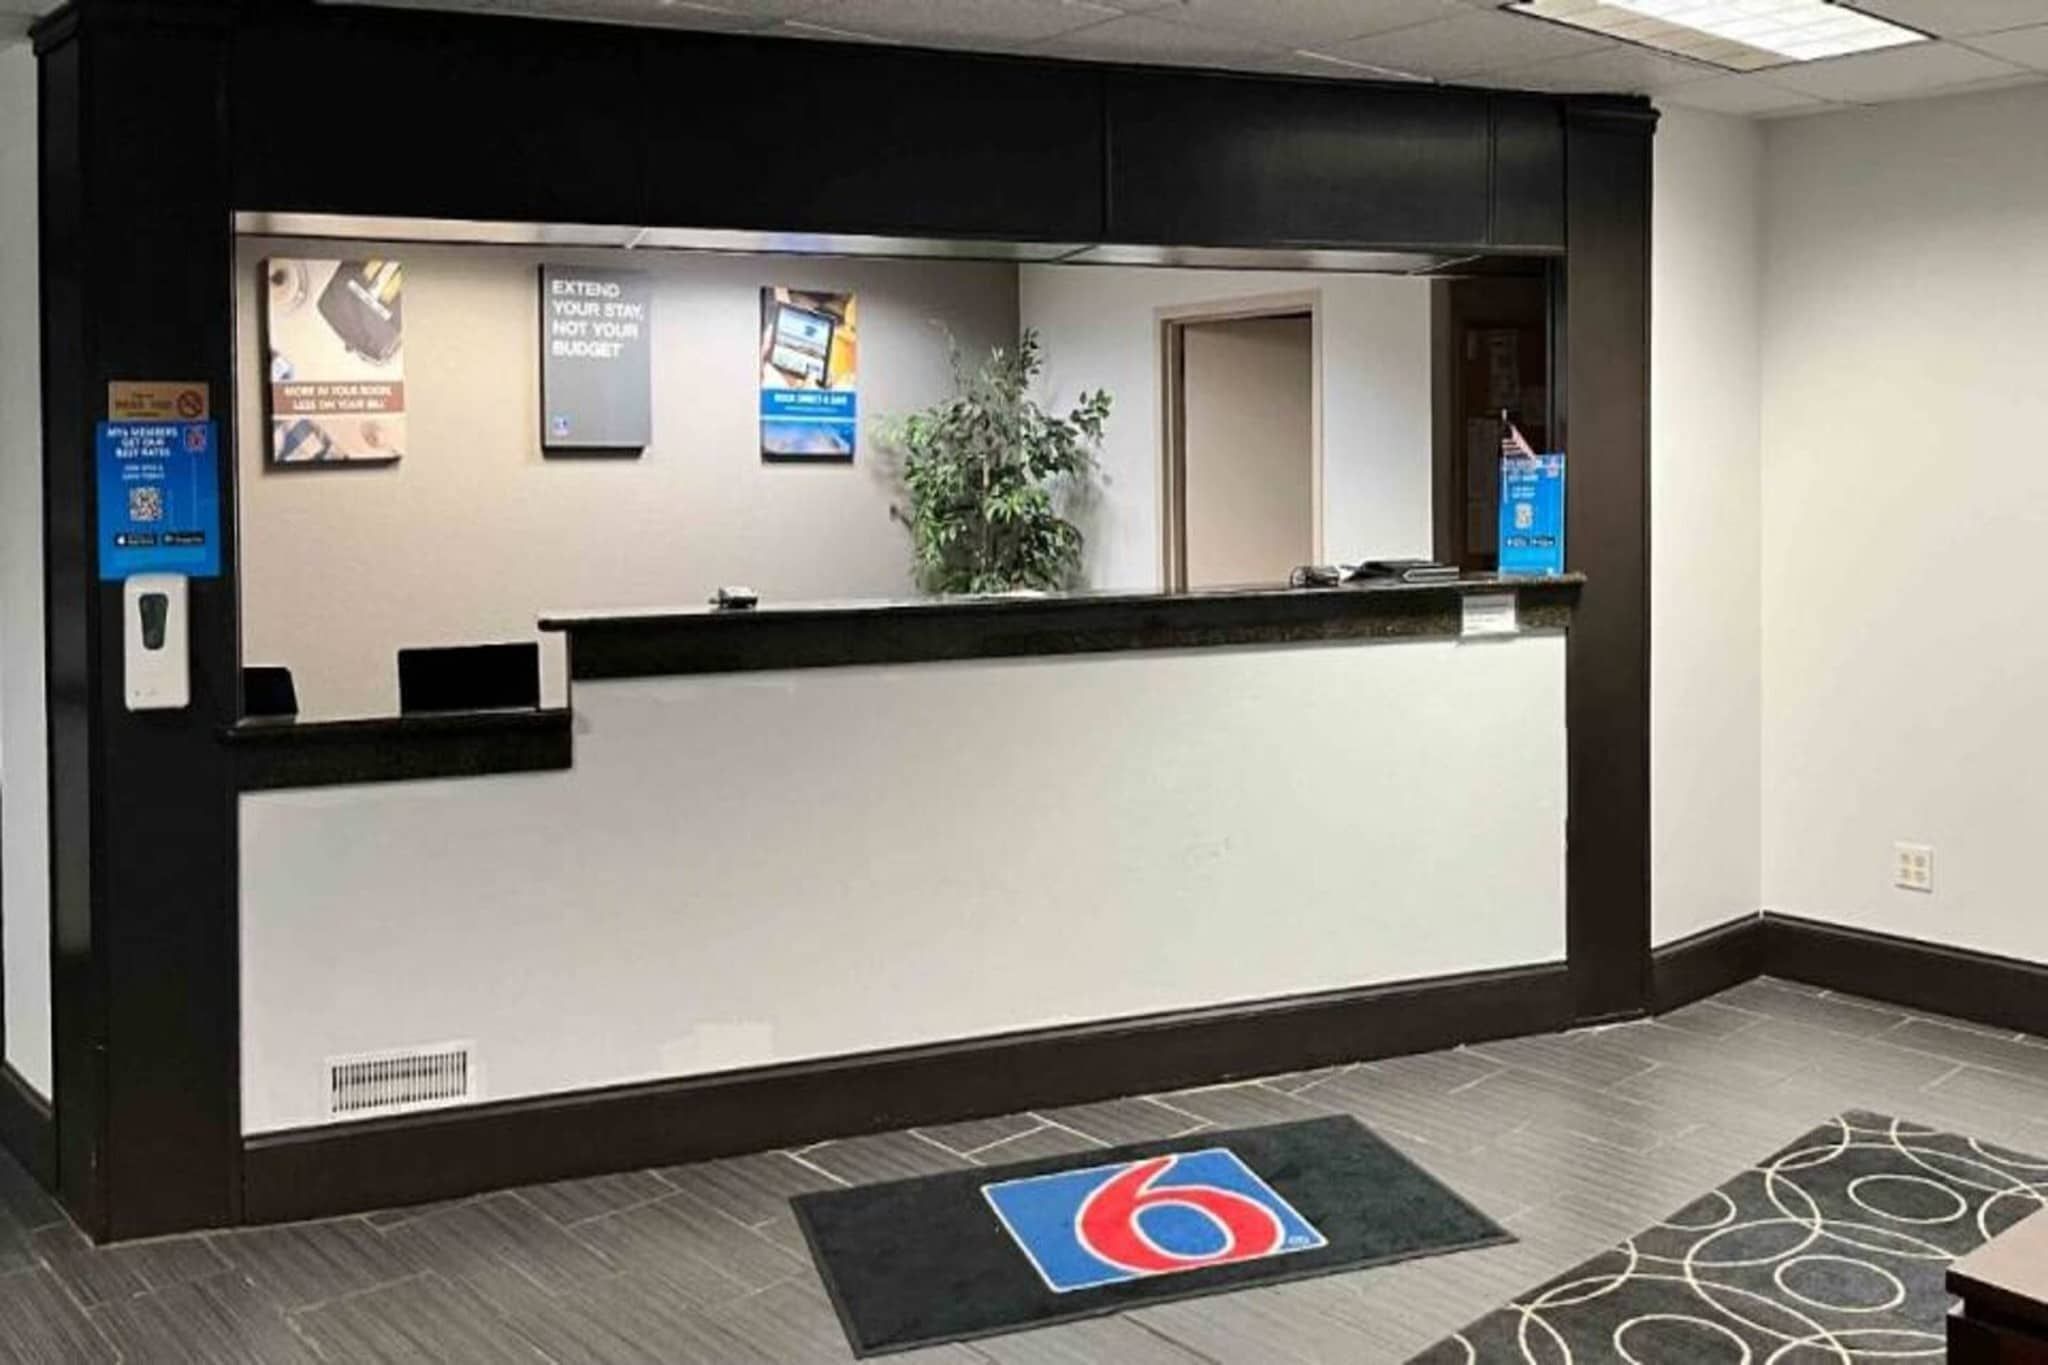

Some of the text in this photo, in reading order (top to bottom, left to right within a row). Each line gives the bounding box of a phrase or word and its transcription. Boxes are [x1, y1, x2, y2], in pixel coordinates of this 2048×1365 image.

[552, 280, 620, 297] EXTEND
[552, 301, 600, 317] YOUR
[552, 320, 638, 338] NOT YOUR
[552, 340, 624, 357] BUDGET
[1075, 1154, 1285, 1273] 6
